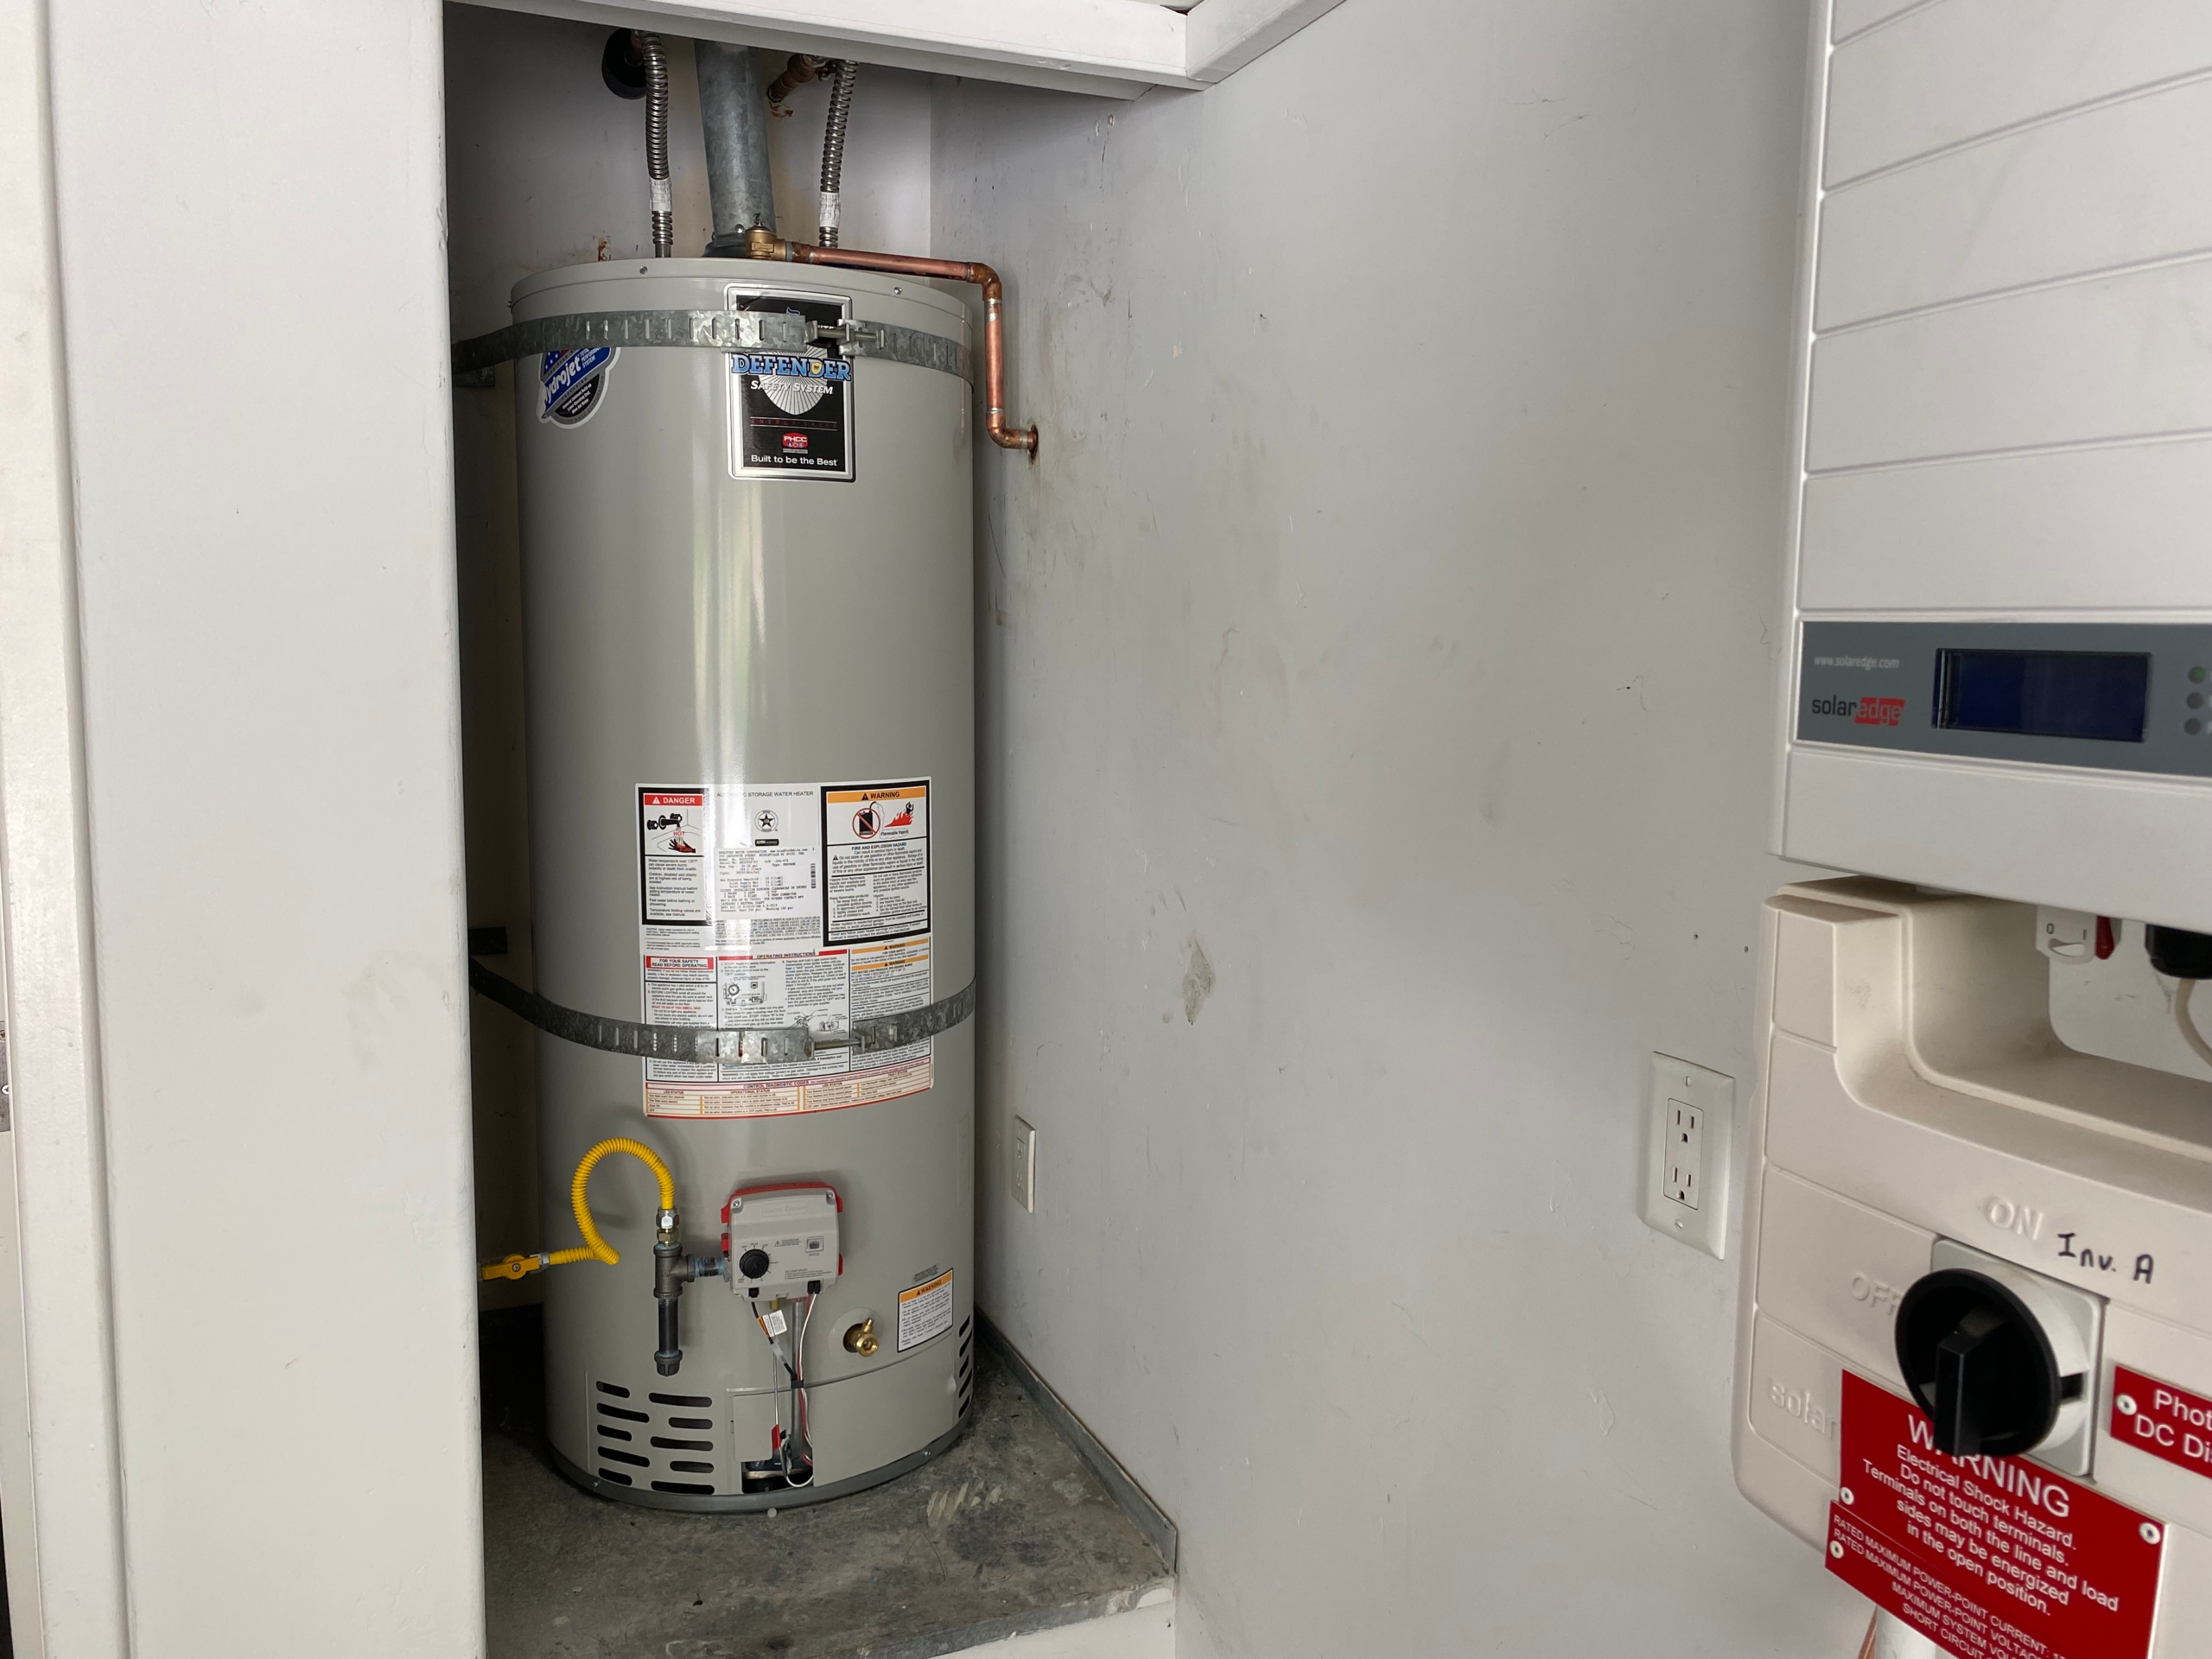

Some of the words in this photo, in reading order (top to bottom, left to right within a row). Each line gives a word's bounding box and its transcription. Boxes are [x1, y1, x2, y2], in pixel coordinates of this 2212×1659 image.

[546, 355, 582, 404] ydrojet
[732, 353, 851, 380] DEFENDER
[750, 380, 791, 391] SAFETY
[792, 383, 834, 395] SYSTEM
[751, 454, 772, 463] Built
[785, 455, 798, 464] be
[817, 458, 838, 467] Best
[1815, 655, 1900, 671] www.solaredge.com
[1811, 694, 1904, 727] solaredge
[870, 791, 900, 799] WARNING
[1986, 1196, 2044, 1241] ON
[2056, 1232, 2117, 1273] Inv.
[2133, 1254, 2154, 1284] A
[920, 1279, 942, 1294] WARNING
[2135, 1414, 2175, 1447] DC
[2183, 1433, 2212, 1465] Di
[1897, 1444, 1960, 1490] Electrical
[1963, 1480, 2011, 1516] Shock
[2014, 1506, 2077, 1550] Hazard.
[1901, 1463, 1920, 1484] Do
[1923, 1479, 1946, 1501] not
[1949, 1491, 1989, 1524] touch
[1993, 1515, 2069, 1567] terminals.
[1863, 1458, 1925, 1506] Terminals
[1929, 1501, 1947, 1518] on
[1950, 1510, 1982, 1539] both
[1986, 1529, 2011, 1554] the
[2014, 1544, 2042, 1570] line
[2046, 1566, 2078, 1590] and
[2082, 1580, 2120, 1612] load
[1897, 1500, 1932, 1528] sides
[1935, 1522, 1966, 1549] may
[1968, 1538, 1987, 1560] be
[1992, 1555, 2069, 1605] energized
[1834, 1528, 1865, 1555] RATED
[1866, 1549, 1911, 1586] MAXIMUM
[1913, 1580, 1988, 1635] POWER-POINT
[1834, 1514, 1865, 1541] RATED
[1866, 1535, 1911, 1573] MAXIMUM
[1913, 1567, 1988, 1620] POWER-POINT
[1990, 1615, 2050, 1658] CURRENT:
[1907, 1520, 1919, 1538] in
[1923, 1530, 1944, 1553] the
[1947, 1548, 1984, 1577] open
[1986, 1571, 2050, 1617] position.
[1891, 1580, 1941, 1620] MAXIMUM
[1942, 1614, 1986, 1649] SYSTEM
[1903, 1602, 1939, 1632] SHORT
[1941, 1628, 1985, 1659] CIRCUIT
